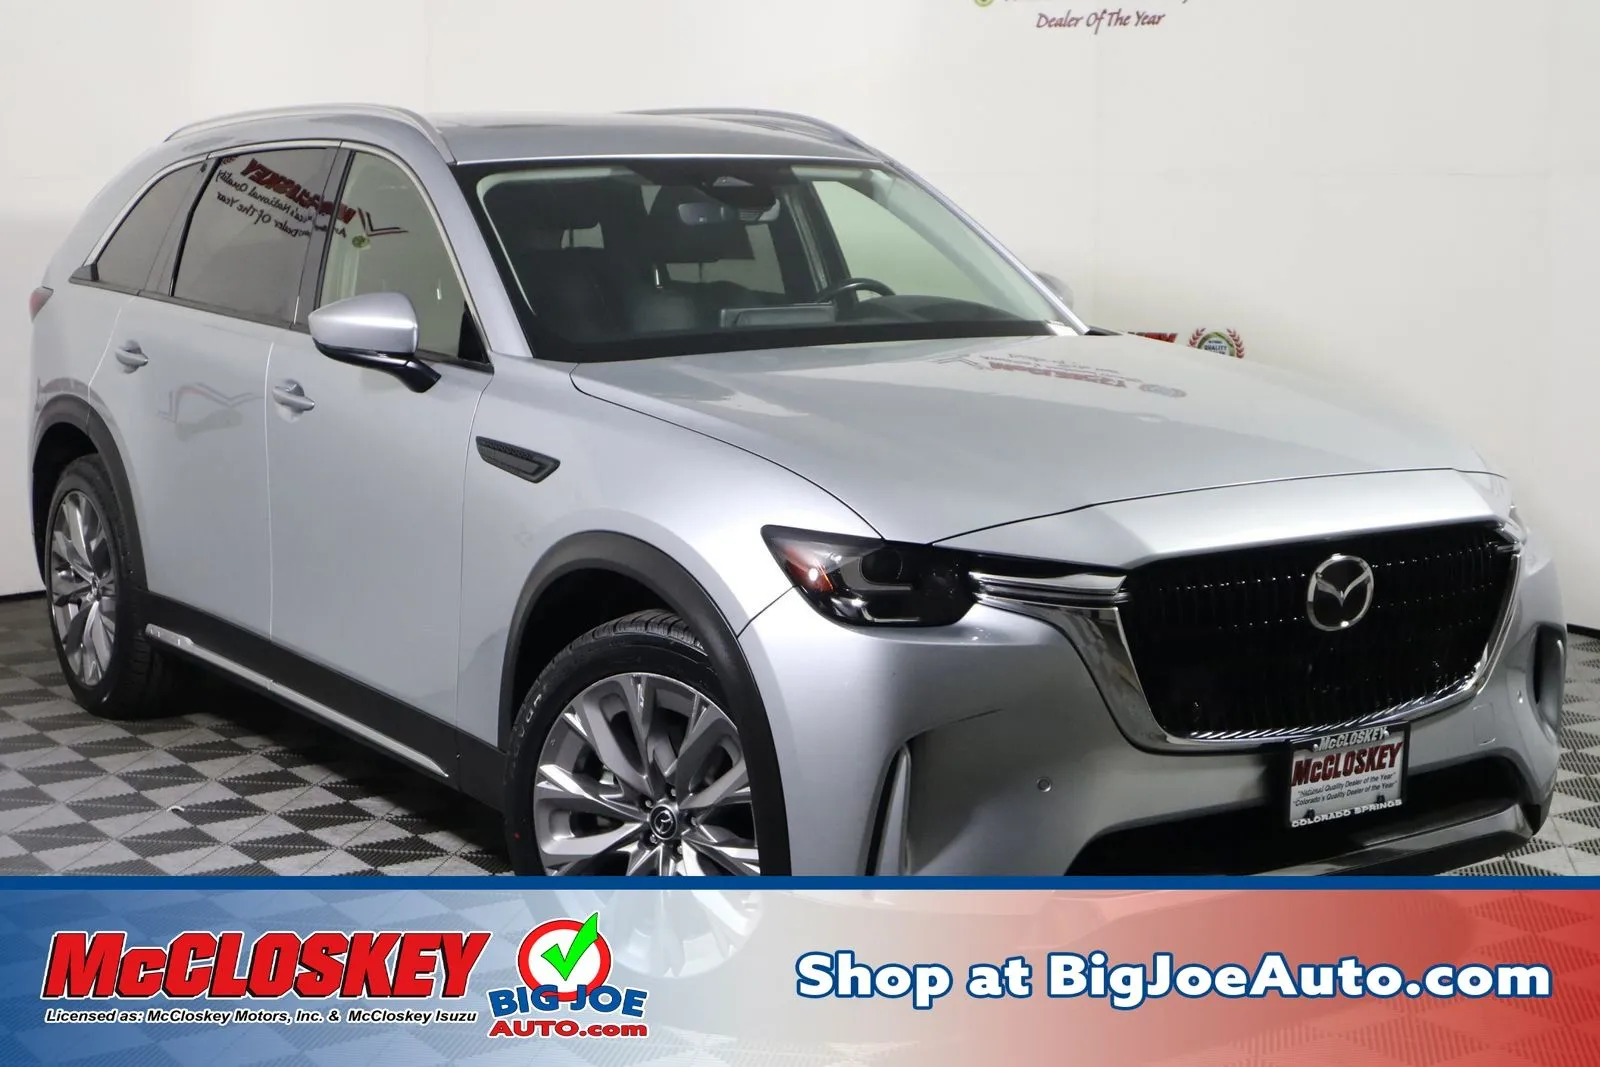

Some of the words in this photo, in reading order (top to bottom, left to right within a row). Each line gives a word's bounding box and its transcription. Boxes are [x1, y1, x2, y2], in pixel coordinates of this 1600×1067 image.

[1036, 9, 1083, 28] Dealer
[1086, 9, 1106, 35] Of
[1107, 8, 1130, 27] The
[1135, 11, 1166, 26] Year
[1320, 726, 1388, 751] McCLOSKEY
[1291, 742, 1403, 786] McCLOSKEY
[1345, 779, 1363, 788] Dealer
[1346, 788, 1364, 797] Dealer
[1291, 808, 1352, 828] COLORADO
[1354, 799, 1403, 815] SPRINGS
